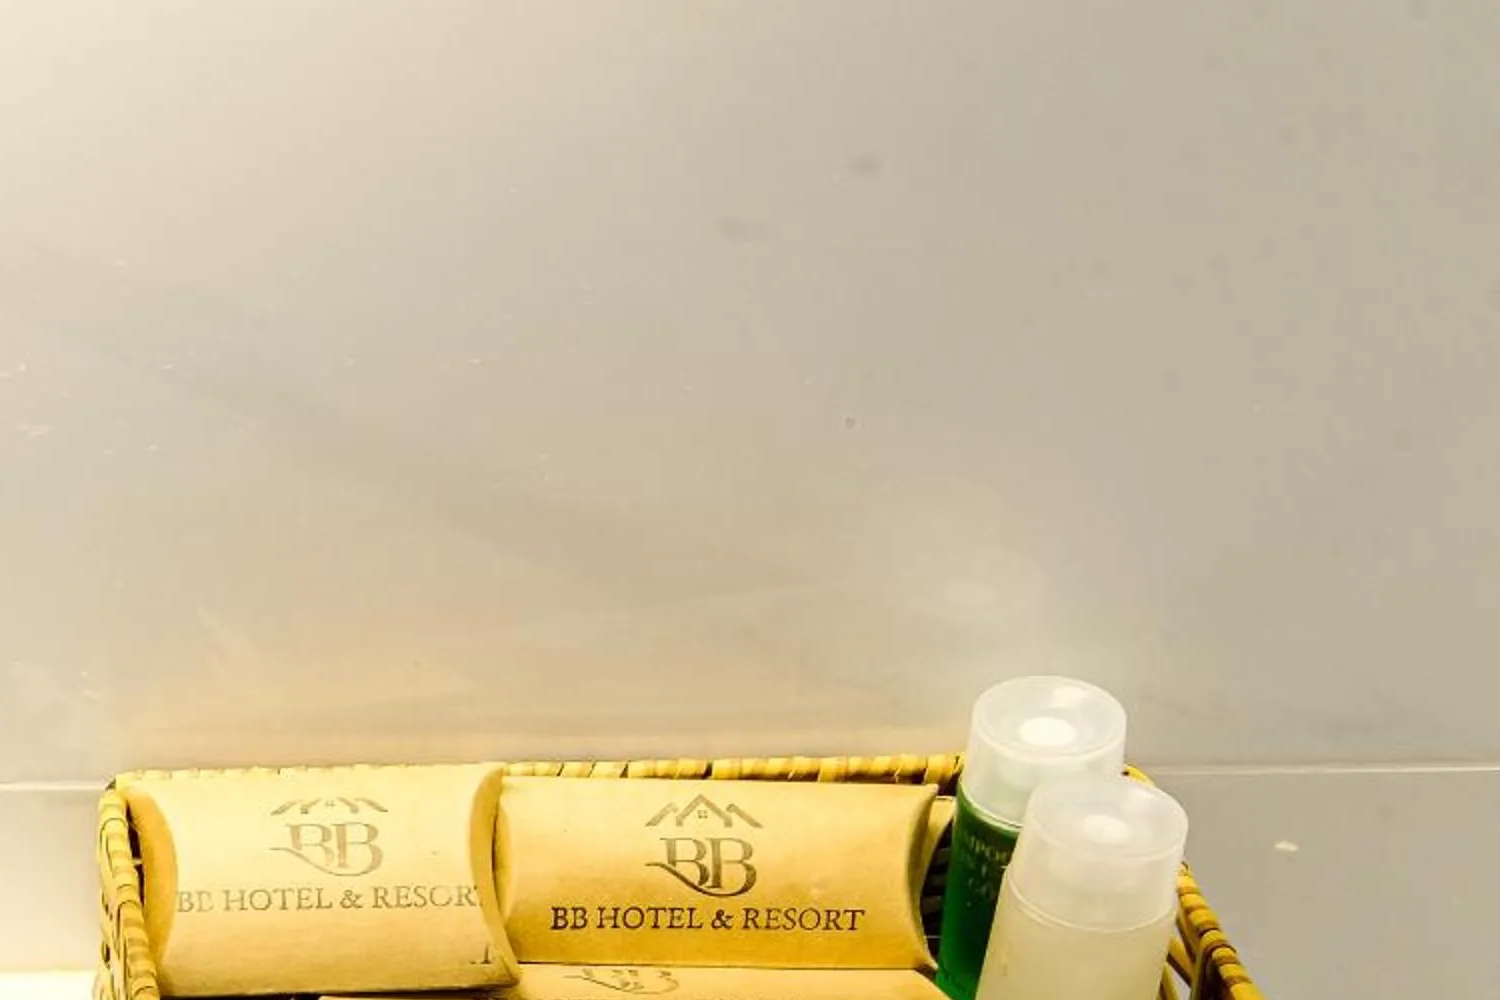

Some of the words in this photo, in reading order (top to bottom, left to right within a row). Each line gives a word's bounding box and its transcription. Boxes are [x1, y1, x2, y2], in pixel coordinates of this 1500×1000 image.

[222, 886, 333, 912] HOTEL
[340, 887, 364, 909] &
[372, 884, 483, 911] RESOR
[550, 906, 589, 931] BB
[595, 906, 704, 931] HOTEL
[710, 909, 734, 929] &
[741, 907, 866, 932] RESORT
